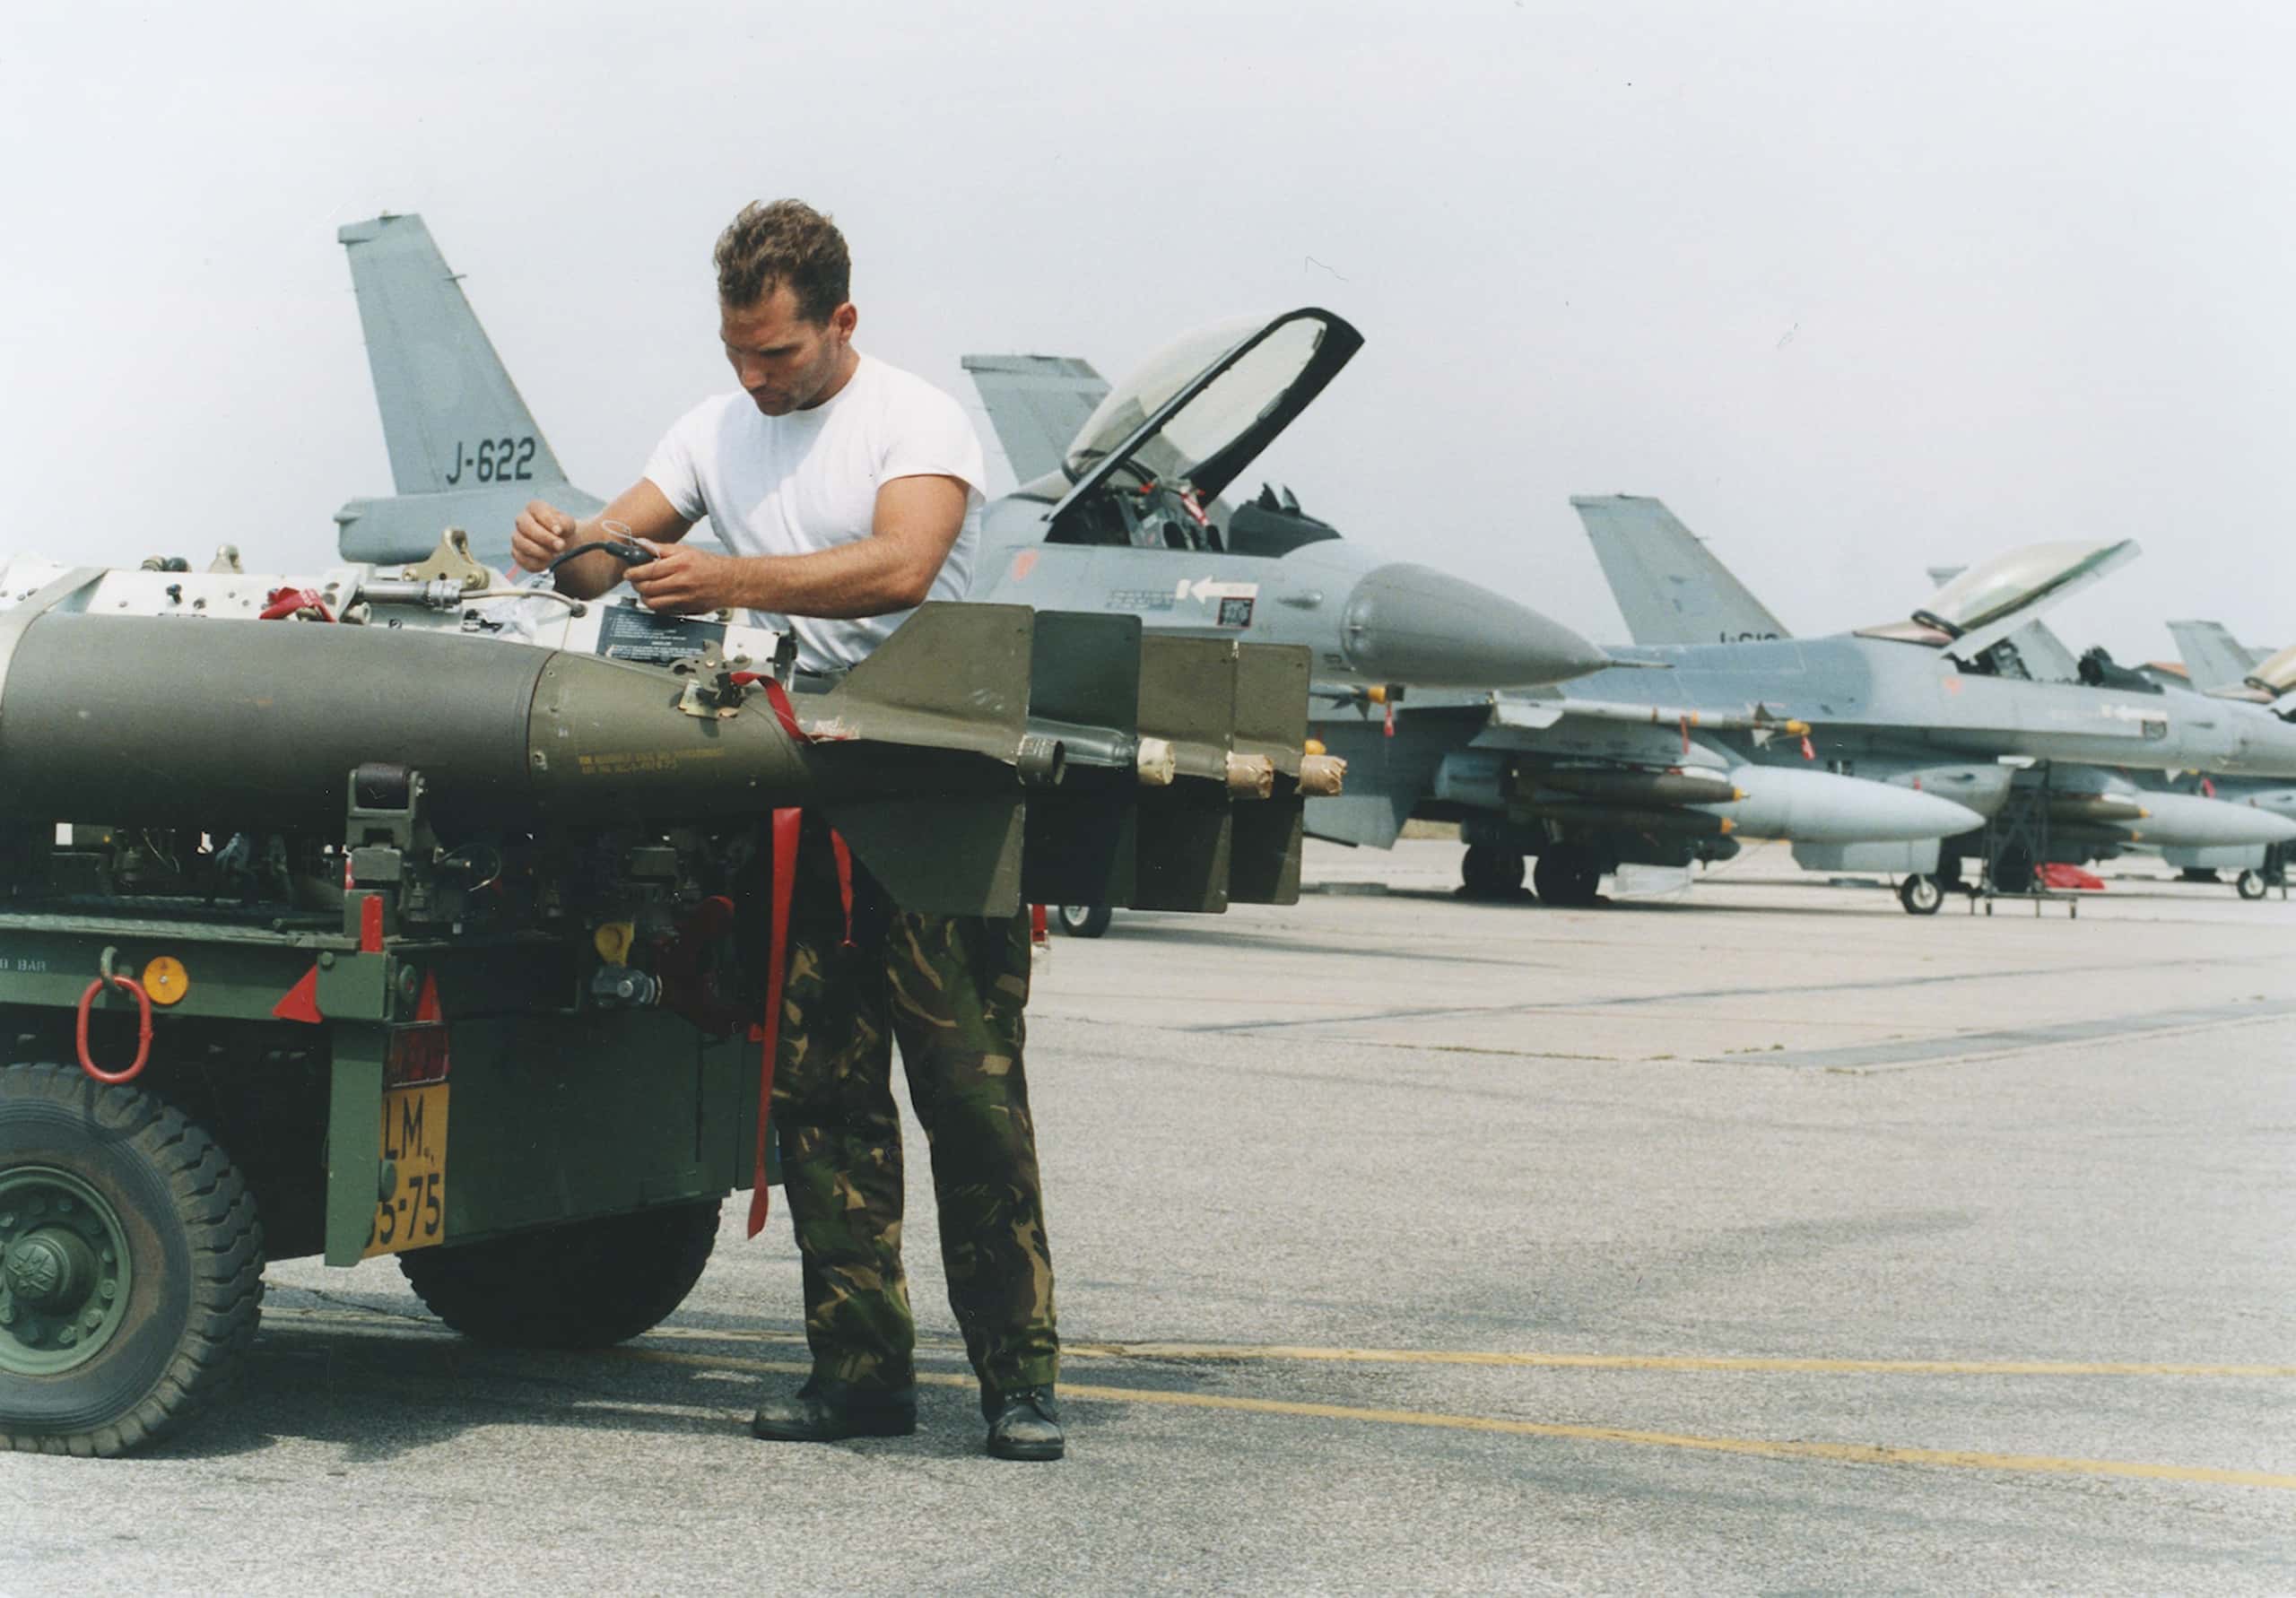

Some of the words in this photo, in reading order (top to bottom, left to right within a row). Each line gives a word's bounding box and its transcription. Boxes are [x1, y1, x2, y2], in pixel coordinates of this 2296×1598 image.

[446, 437, 535, 484] J-622
[385, 1093, 424, 1159] LM
[364, 1173, 440, 1248] 5-75
